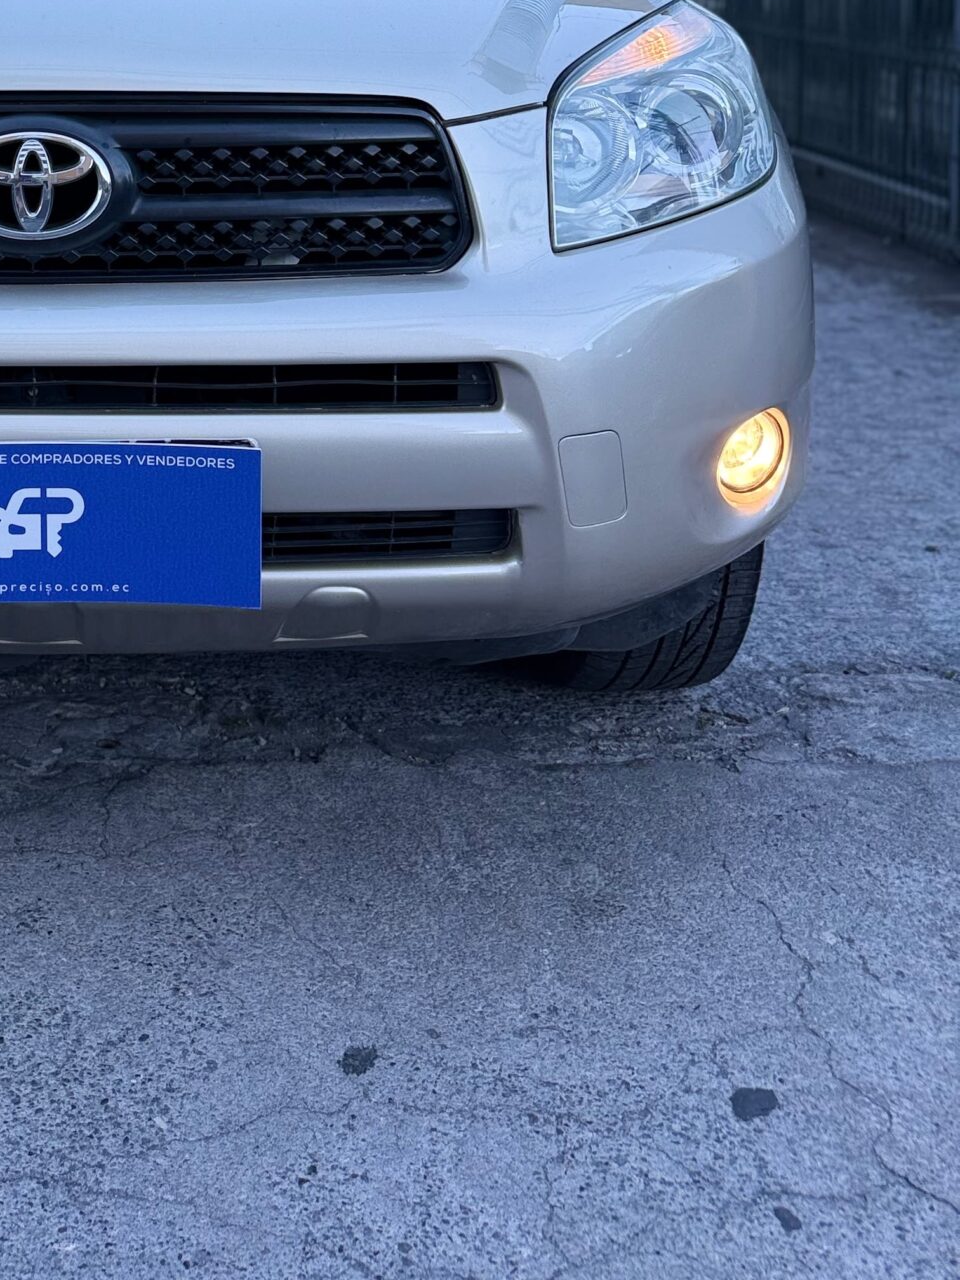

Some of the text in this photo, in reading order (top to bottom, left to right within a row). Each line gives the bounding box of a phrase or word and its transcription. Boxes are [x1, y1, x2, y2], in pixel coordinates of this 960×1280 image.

[10, 453, 122, 465] COMPRADORES
[125, 454, 134, 465] Y
[136, 455, 235, 470] VENDEDORES
